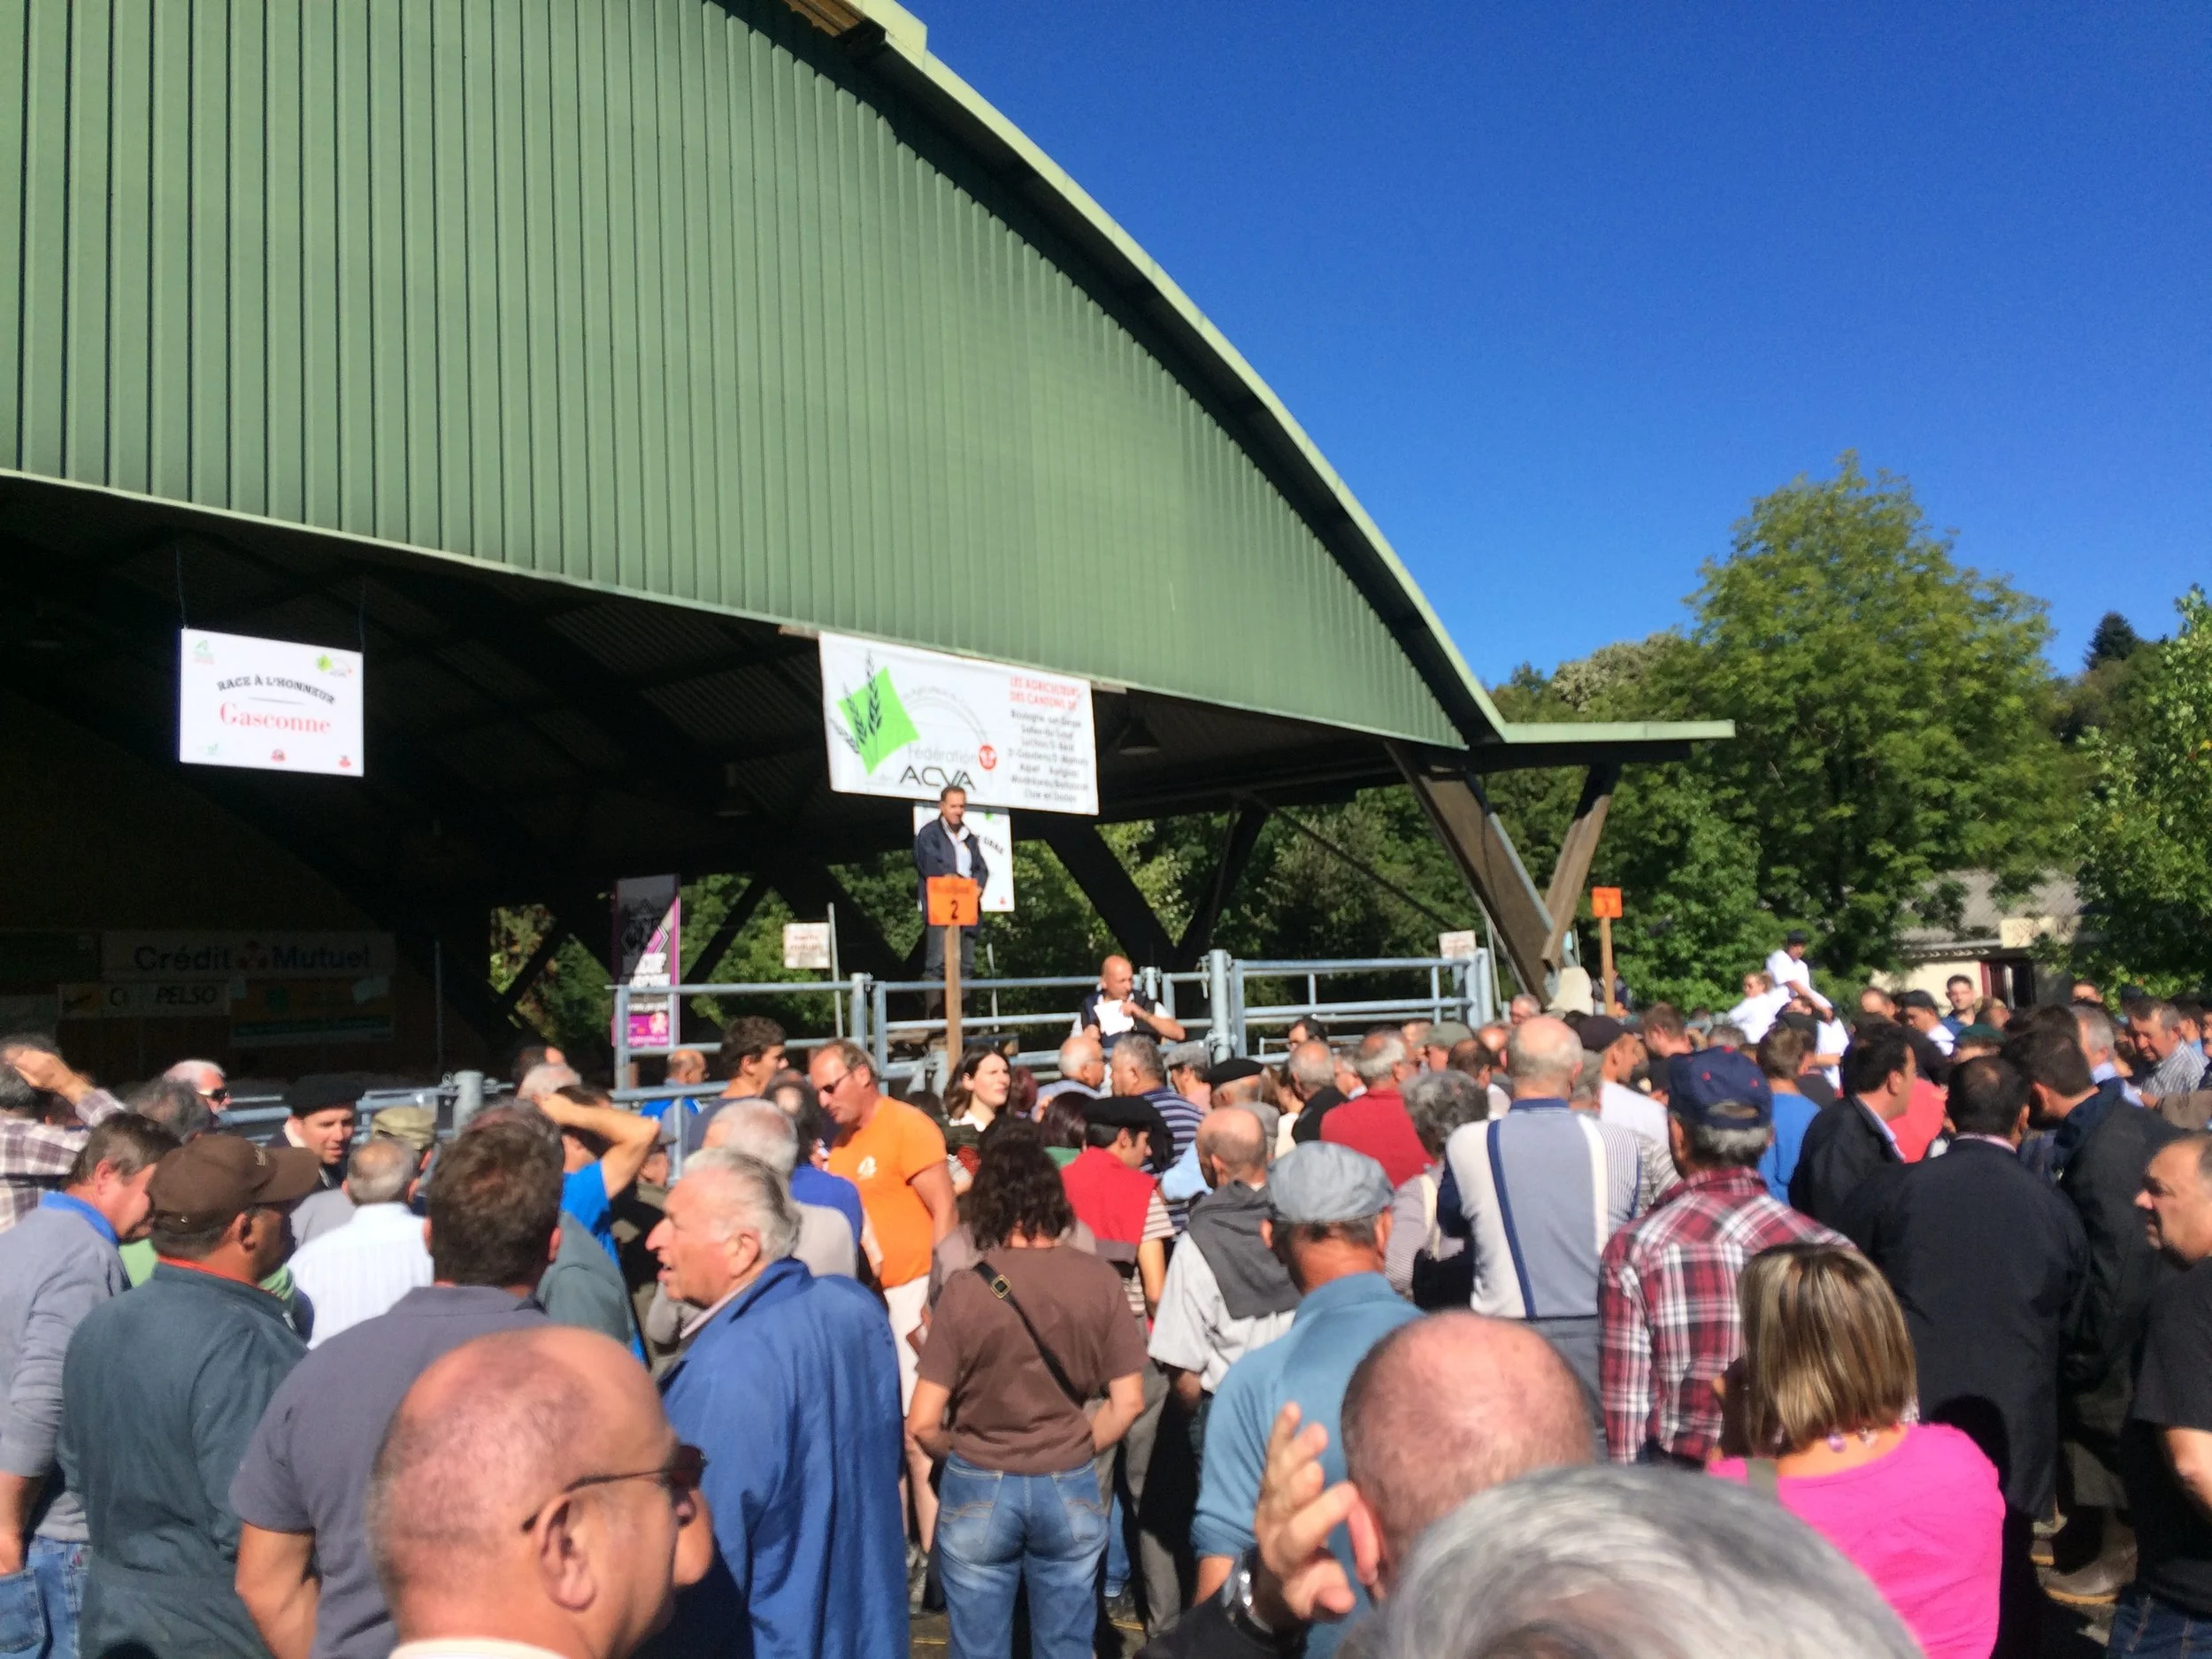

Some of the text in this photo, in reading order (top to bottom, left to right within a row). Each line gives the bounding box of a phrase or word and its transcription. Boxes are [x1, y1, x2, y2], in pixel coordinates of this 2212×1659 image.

[217, 673, 336, 706] RACE À L'HONNEUR
[219, 700, 332, 735] Gasconne
[899, 763, 977, 791] ACVA
[950, 899, 959, 920] 2
[134, 942, 370, 972] Crédit Mutuel
